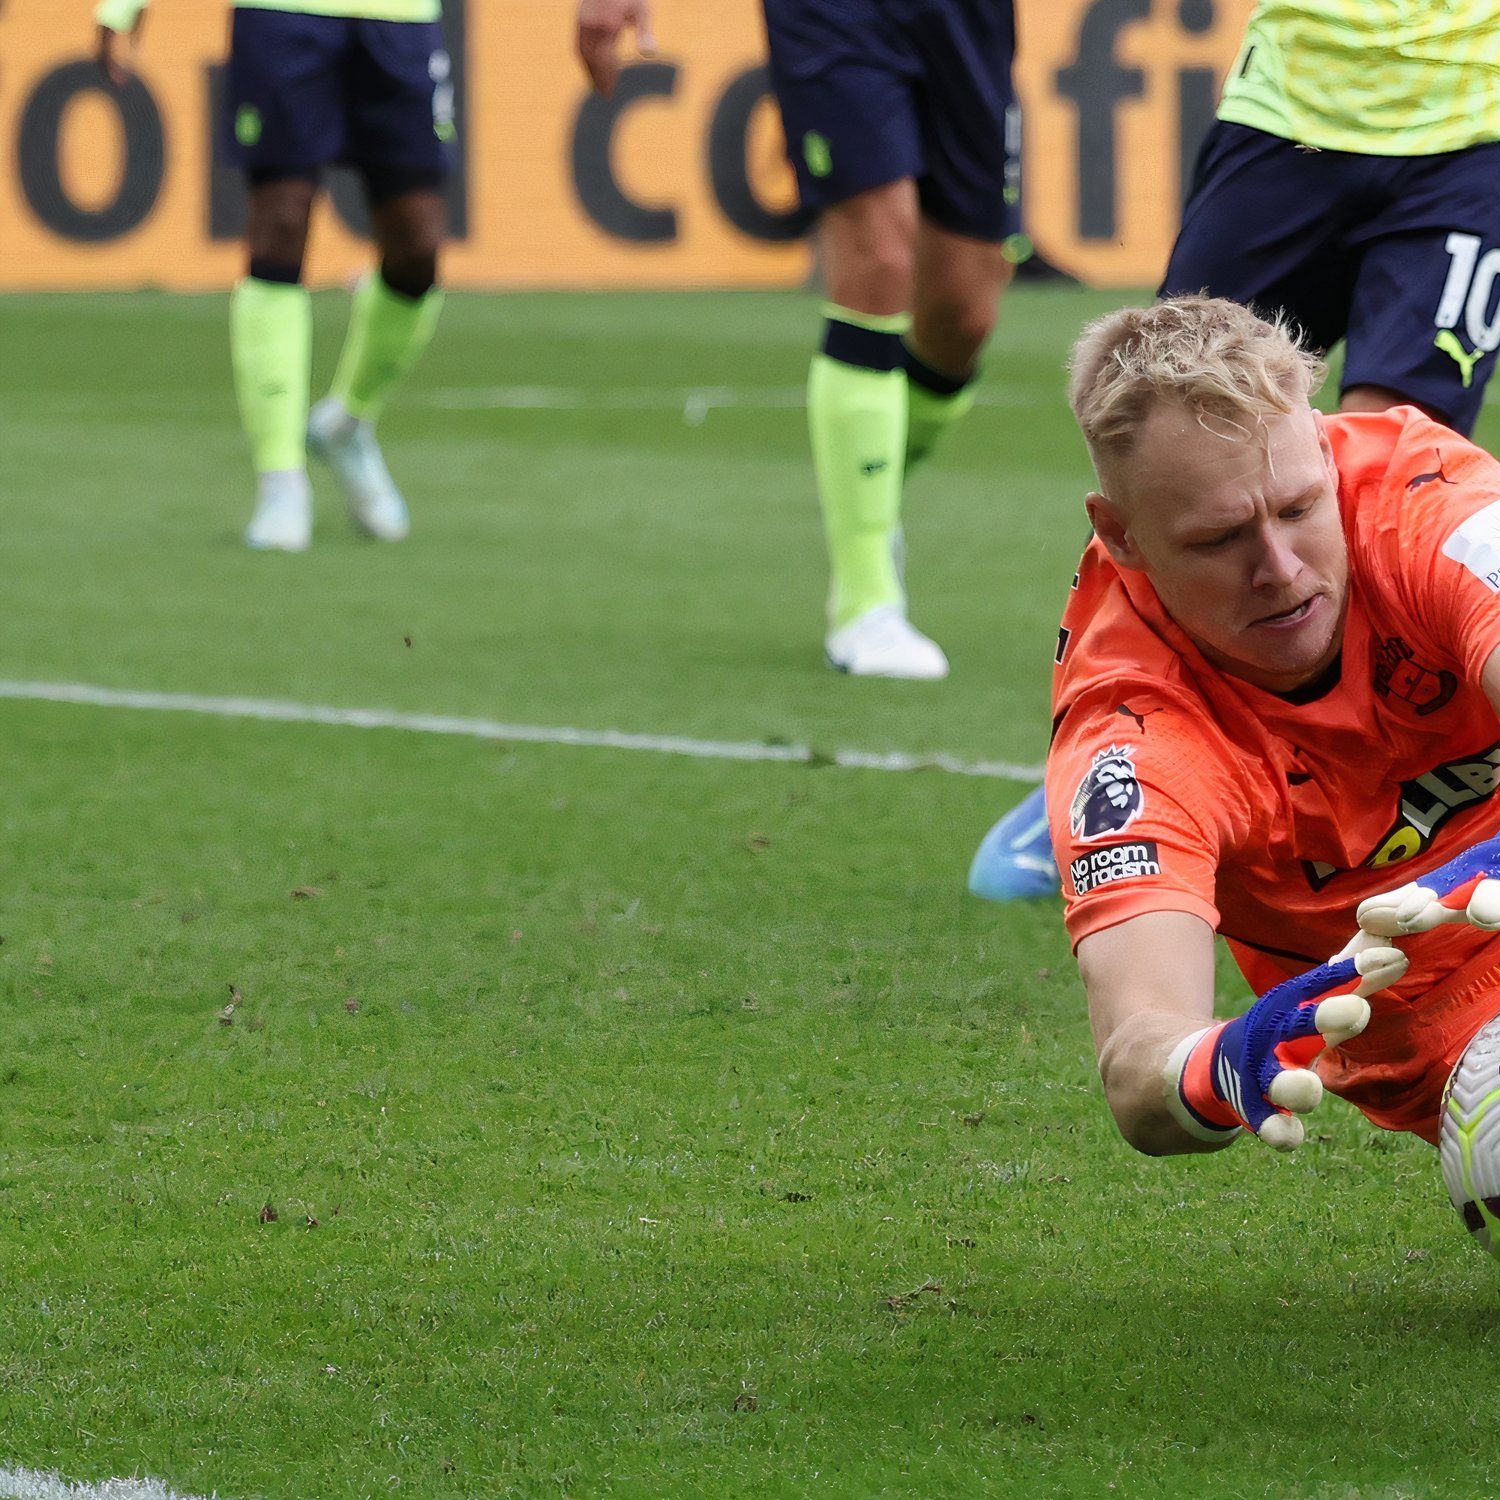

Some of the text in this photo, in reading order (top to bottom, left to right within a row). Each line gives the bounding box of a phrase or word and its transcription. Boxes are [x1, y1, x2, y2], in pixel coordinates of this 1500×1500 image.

[1070, 844, 1148, 880] No room
[1091, 860, 1160, 888] racism
